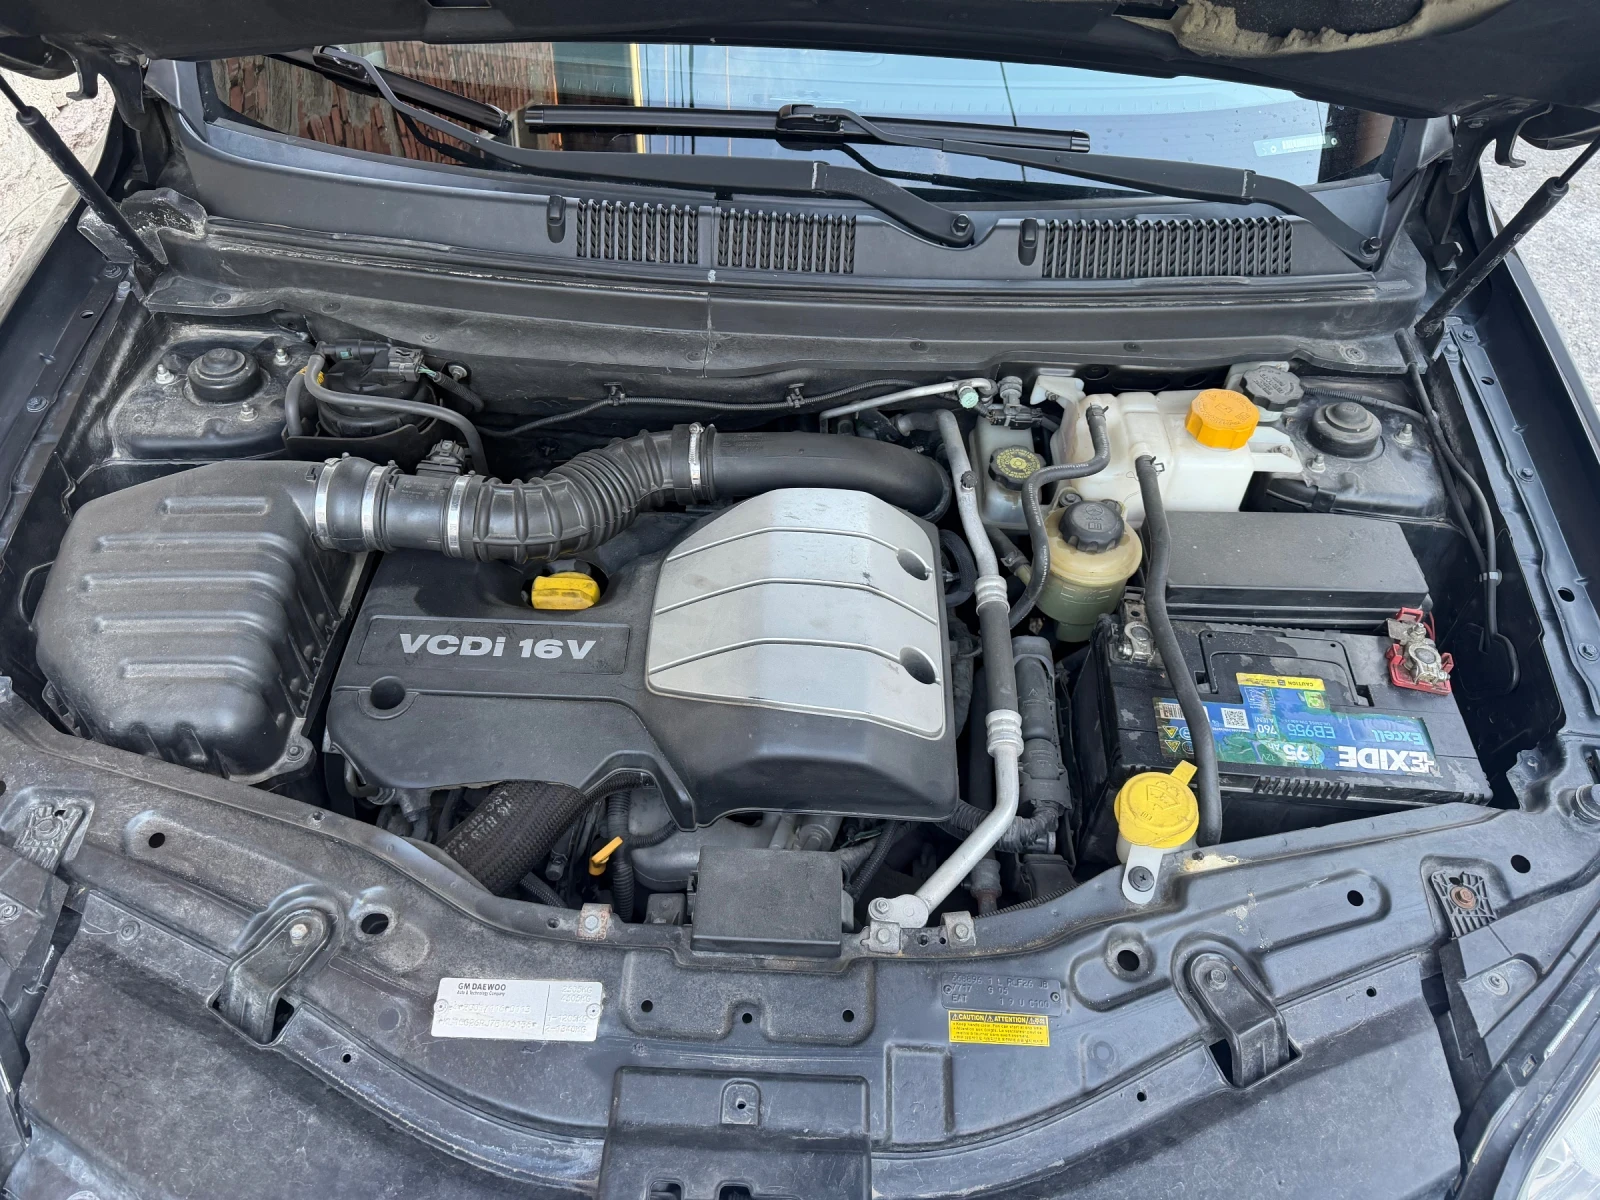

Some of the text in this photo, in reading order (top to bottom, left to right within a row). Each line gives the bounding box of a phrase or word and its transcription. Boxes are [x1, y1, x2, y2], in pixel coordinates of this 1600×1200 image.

[400, 633, 597, 660] VCDi 16V
[1257, 723, 1276, 734] 760
[1286, 723, 1336, 739] EB955
[1371, 729, 1425, 746] Excell
[1261, 753, 1275, 761] 12V
[1282, 743, 1310, 762] 95
[1337, 745, 1435, 774] EXIDE
[458, 982, 507, 991] GM DAEWOO
